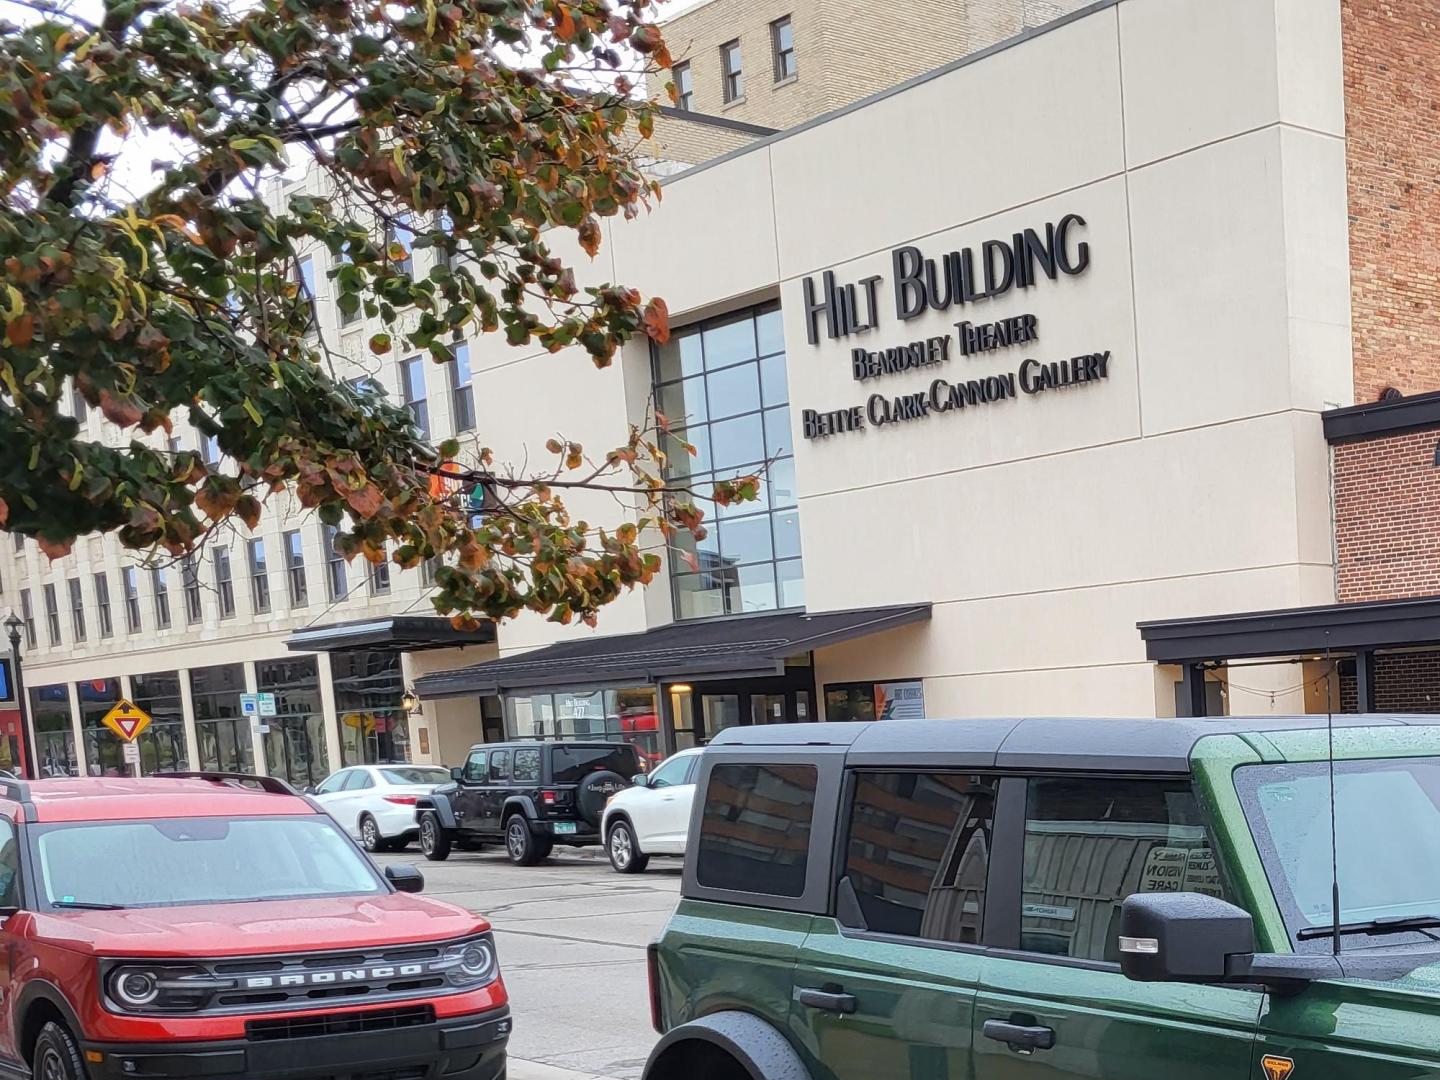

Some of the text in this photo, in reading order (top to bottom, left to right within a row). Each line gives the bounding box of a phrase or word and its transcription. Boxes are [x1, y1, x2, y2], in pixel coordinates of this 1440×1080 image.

[802, 213, 1090, 345] HILT BUILDING
[851, 314, 1038, 380] BEARDSLEY THEATER
[802, 406, 865, 439] BETTYE
[1018, 351, 1111, 394] GALLERY
[247, 964, 422, 988] BRONCO
